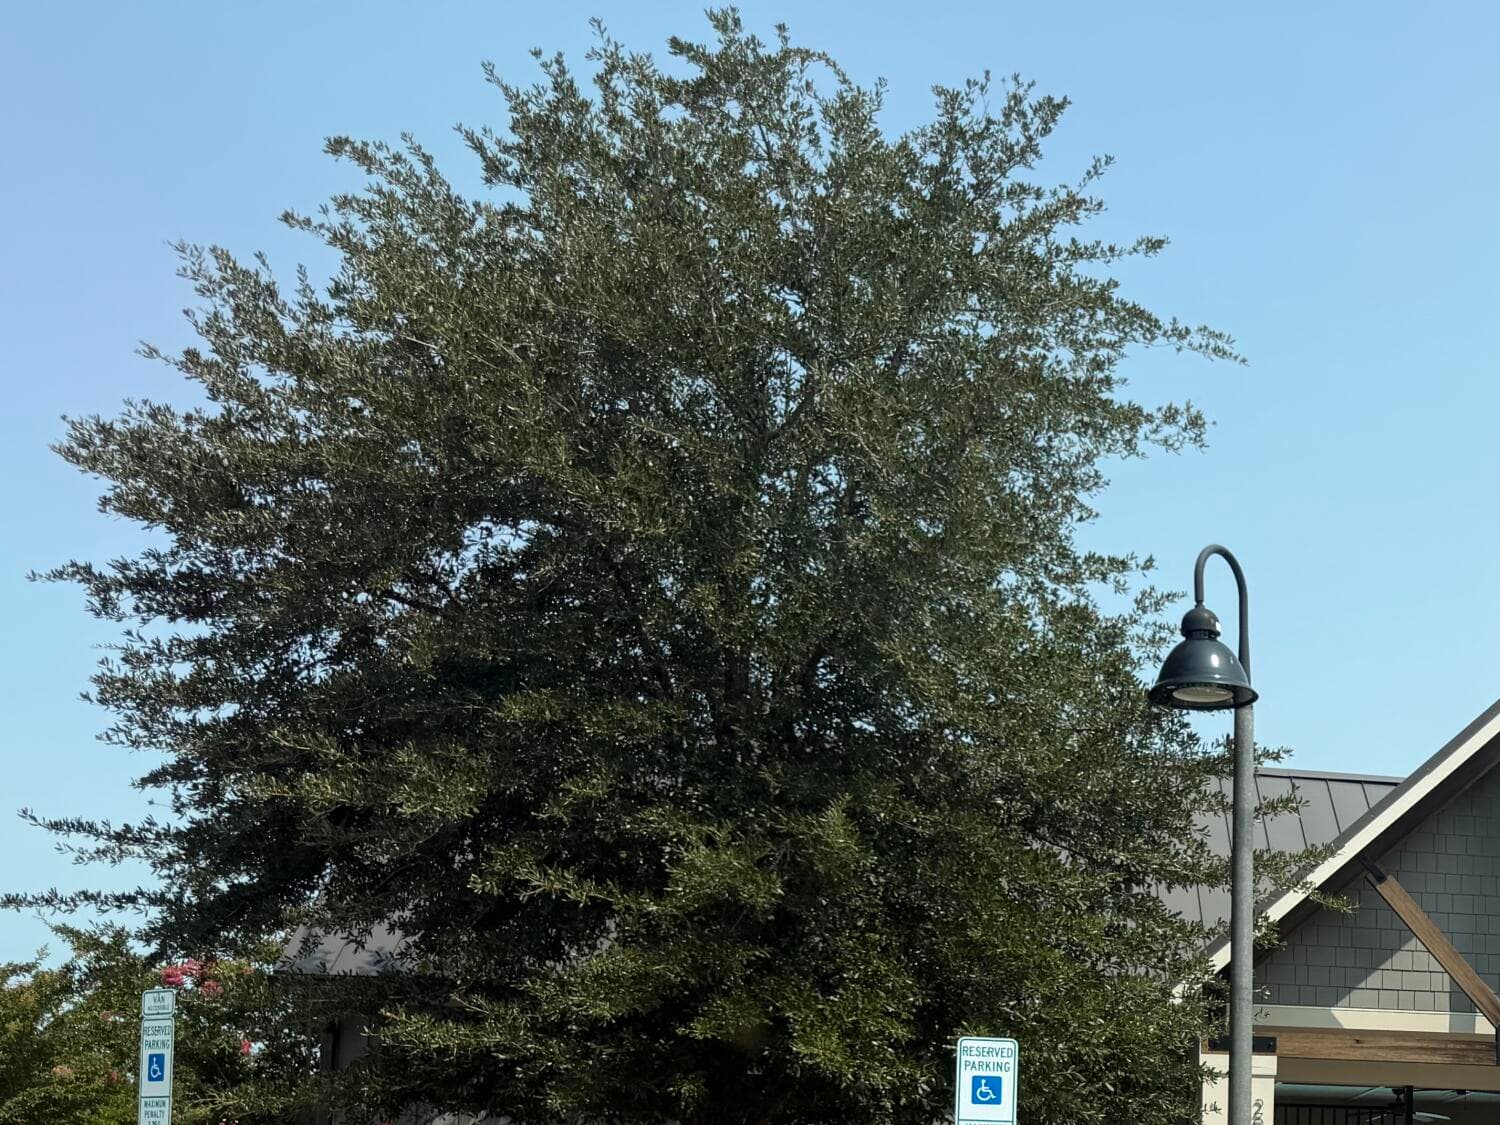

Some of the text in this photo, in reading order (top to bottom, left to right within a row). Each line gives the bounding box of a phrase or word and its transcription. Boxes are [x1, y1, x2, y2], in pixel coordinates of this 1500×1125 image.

[153, 995, 165, 1003] VAN
[144, 1025, 171, 1036] RESERVED
[144, 1039, 170, 1050] PARKING
[962, 1046, 1013, 1058] RESERVED
[964, 1060, 1010, 1072] PARKING
[144, 1100, 166, 1108] MAXIMUM
[144, 1110, 165, 1119] PENALTY
